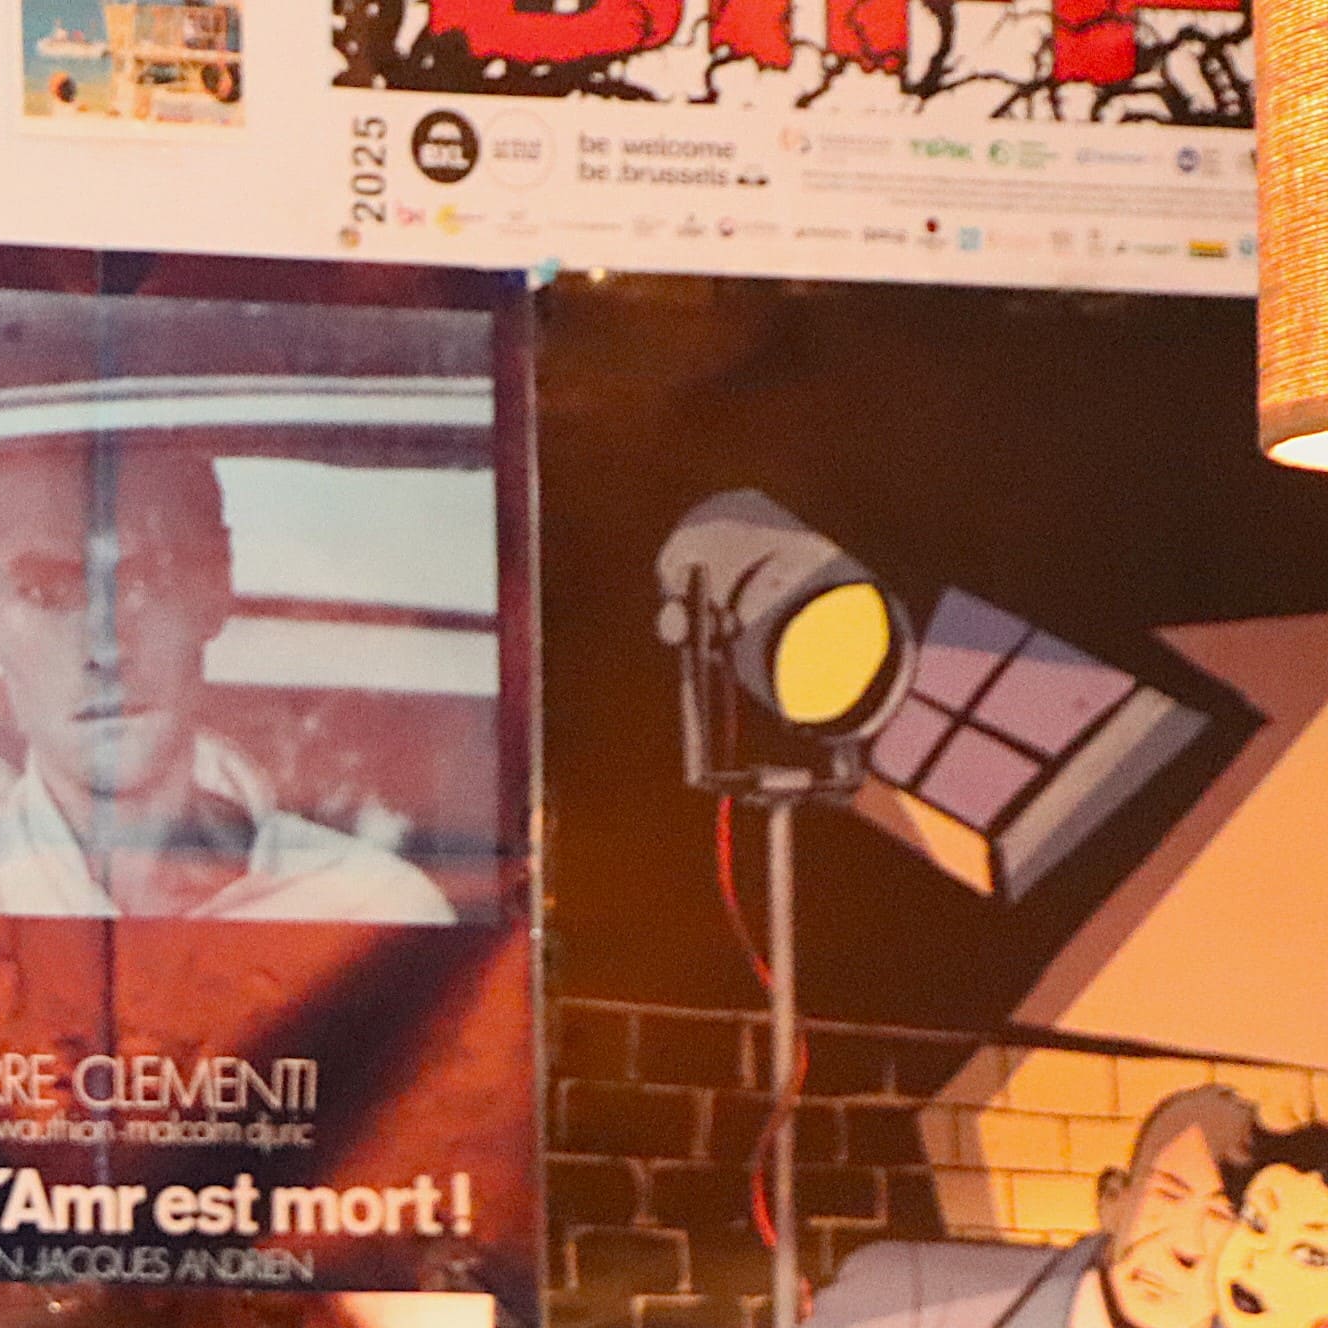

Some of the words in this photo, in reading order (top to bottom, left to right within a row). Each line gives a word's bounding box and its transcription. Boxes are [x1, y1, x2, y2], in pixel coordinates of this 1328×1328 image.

[352, 116, 388, 223] 2025
[72, 1053, 319, 1112] CLEMENTI
[154, 1172, 261, 1237] est
[270, 1173, 444, 1237] mort
